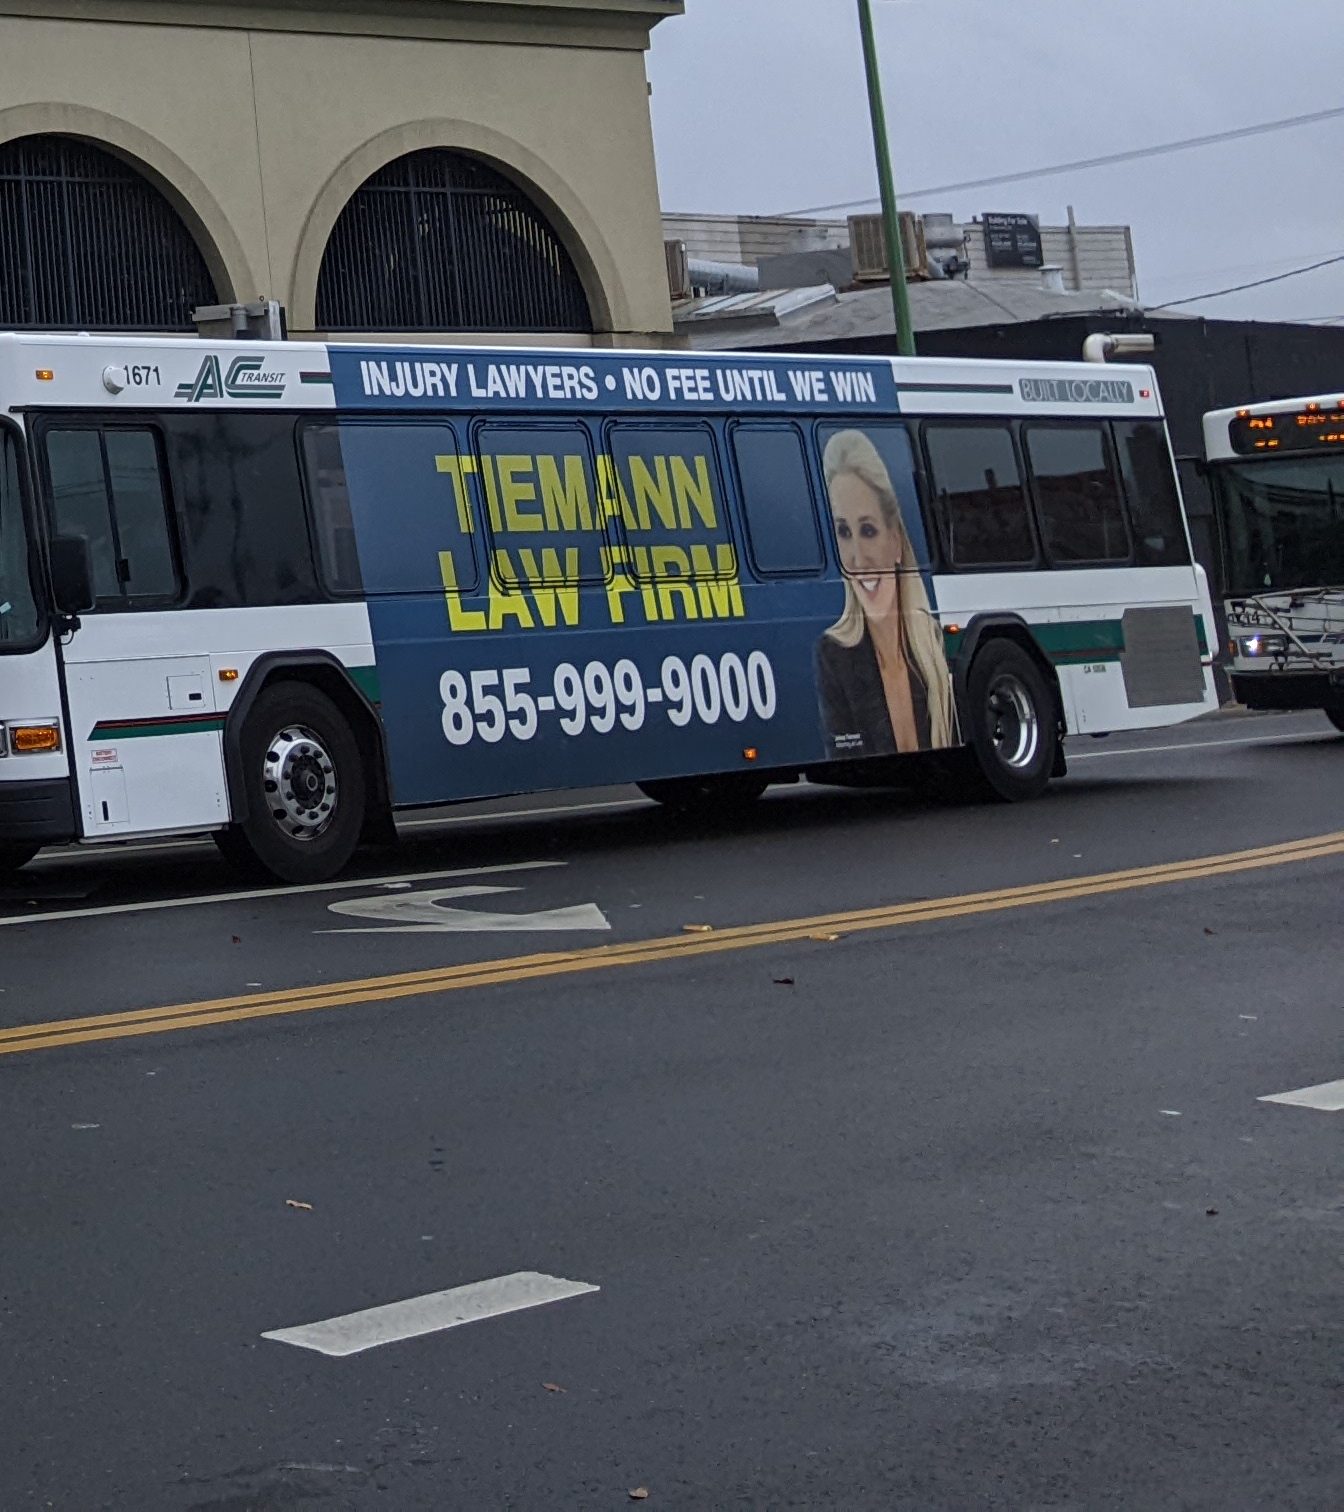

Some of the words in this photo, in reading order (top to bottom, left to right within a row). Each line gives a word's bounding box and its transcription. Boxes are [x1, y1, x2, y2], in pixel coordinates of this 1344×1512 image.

[123, 364, 162, 387] 1671
[240, 371, 286, 384] TRANSIT
[360, 360, 459, 398] INJURY
[467, 363, 599, 400] LAWYERS
[621, 366, 661, 402] NO
[665, 367, 715, 402] FEE
[715, 368, 787, 403] UNTIL
[787, 369, 829, 403] WE
[829, 370, 877, 403] WIN
[1021, 378, 1060, 401] BUILT
[1065, 380, 1129, 403] LOCALLY
[435, 455, 717, 533] TIEMANN
[437, 546, 580, 633] LAW
[600, 542, 746, 624] FIRM
[438, 650, 778, 746] 855-999-9000
